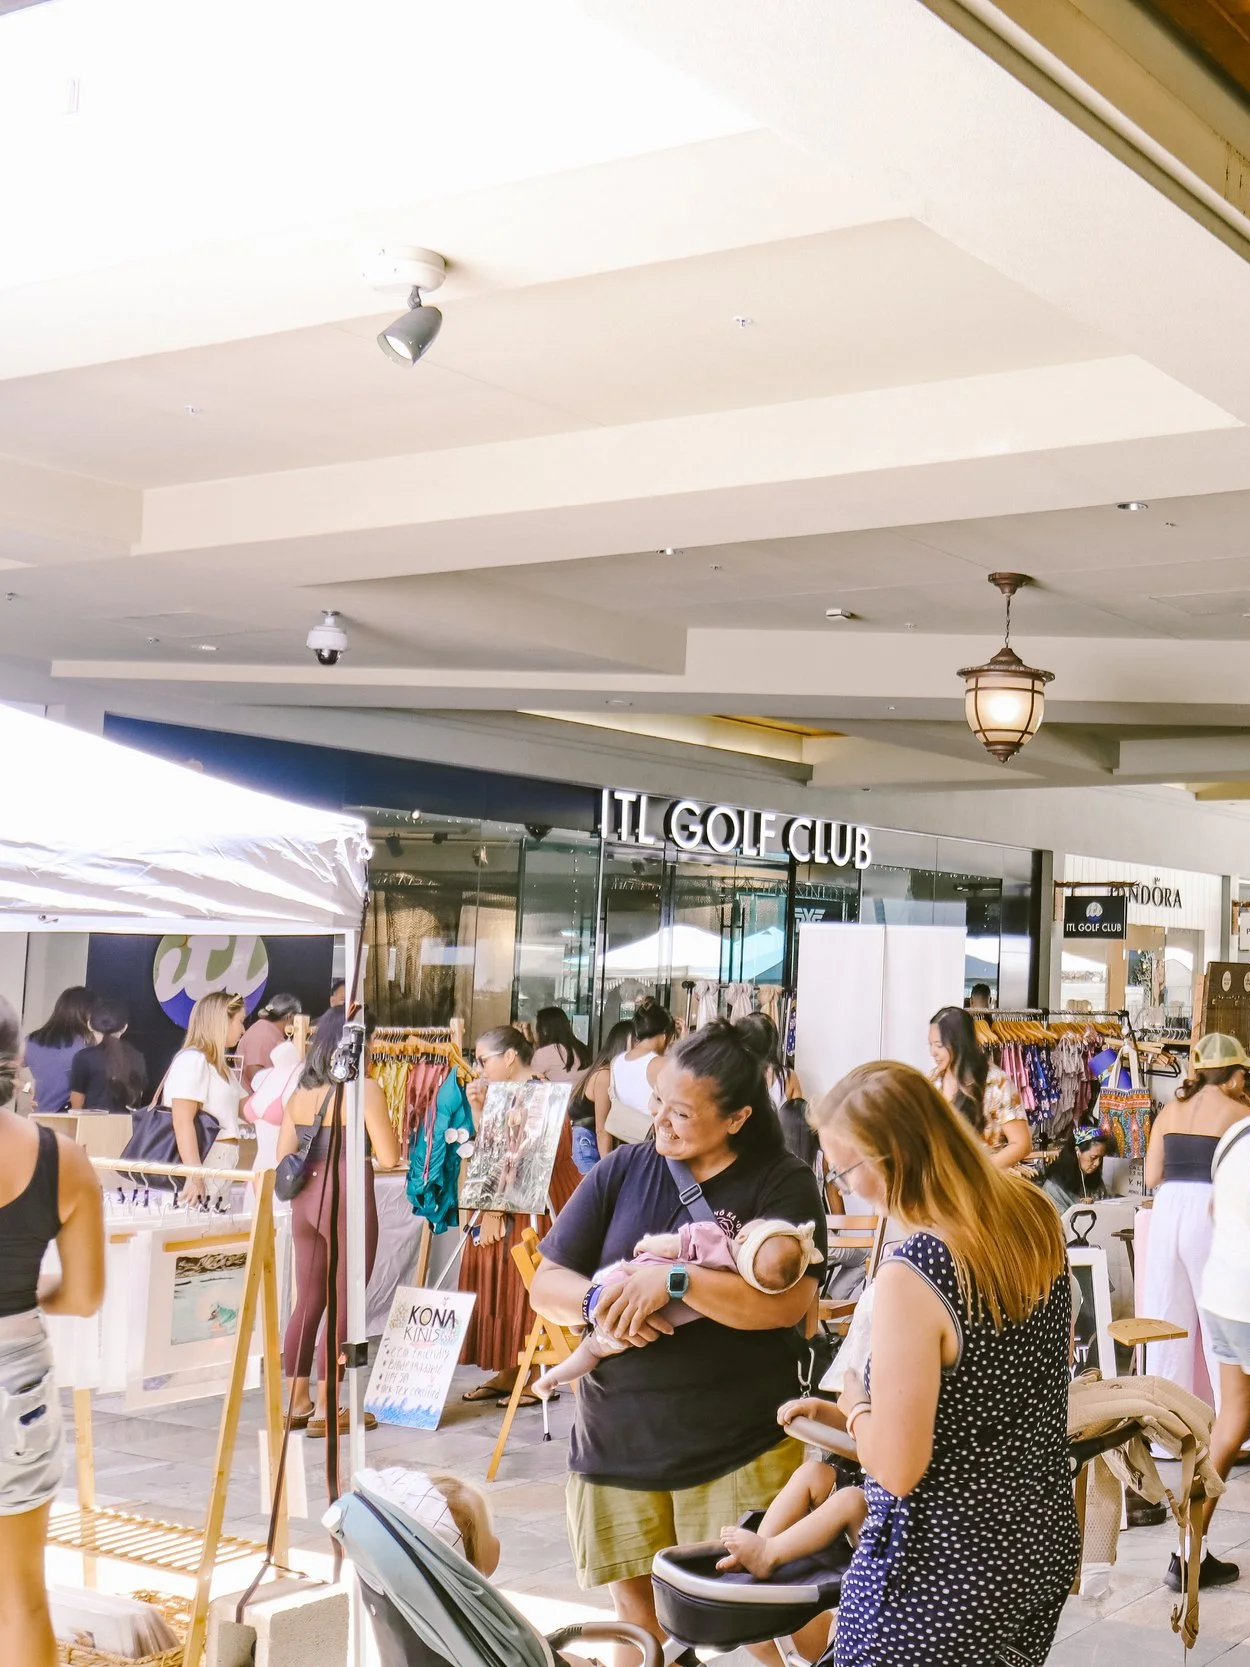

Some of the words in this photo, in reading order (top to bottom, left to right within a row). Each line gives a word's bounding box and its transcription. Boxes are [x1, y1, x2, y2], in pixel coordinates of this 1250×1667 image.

[600, 787, 655, 846] ITL
[668, 799, 776, 858] GOLF
[786, 817, 872, 870] CLUB
[1066, 923, 1076, 932] ITL
[1078, 923, 1099, 932] GOLF
[1102, 923, 1122, 932] CLUB
[408, 1305, 456, 1329] KONA
[403, 1327, 441, 1342] KINIS
